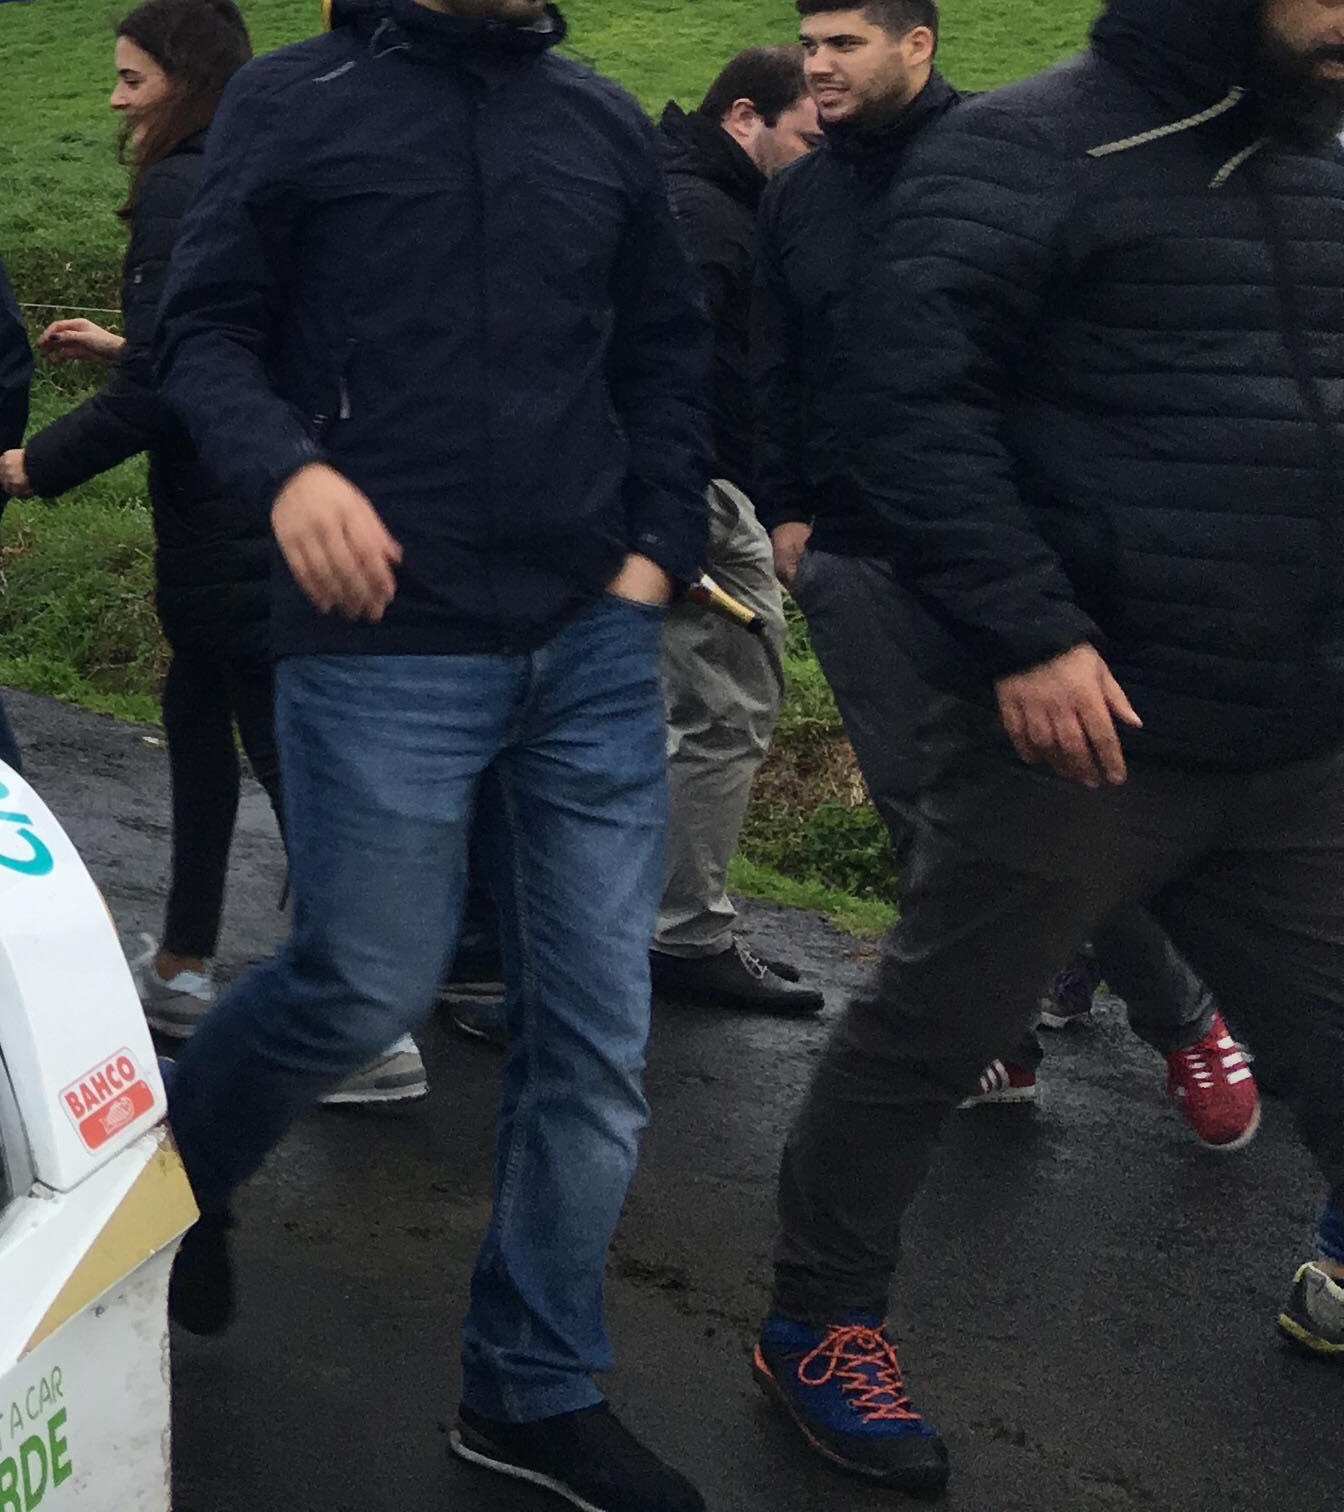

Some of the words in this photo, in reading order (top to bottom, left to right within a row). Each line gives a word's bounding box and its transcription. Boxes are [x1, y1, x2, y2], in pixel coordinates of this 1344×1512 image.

[64, 1055, 136, 1119] BAHCO
[10, 1401, 25, 1439] A
[25, 1365, 64, 1421] CAR
